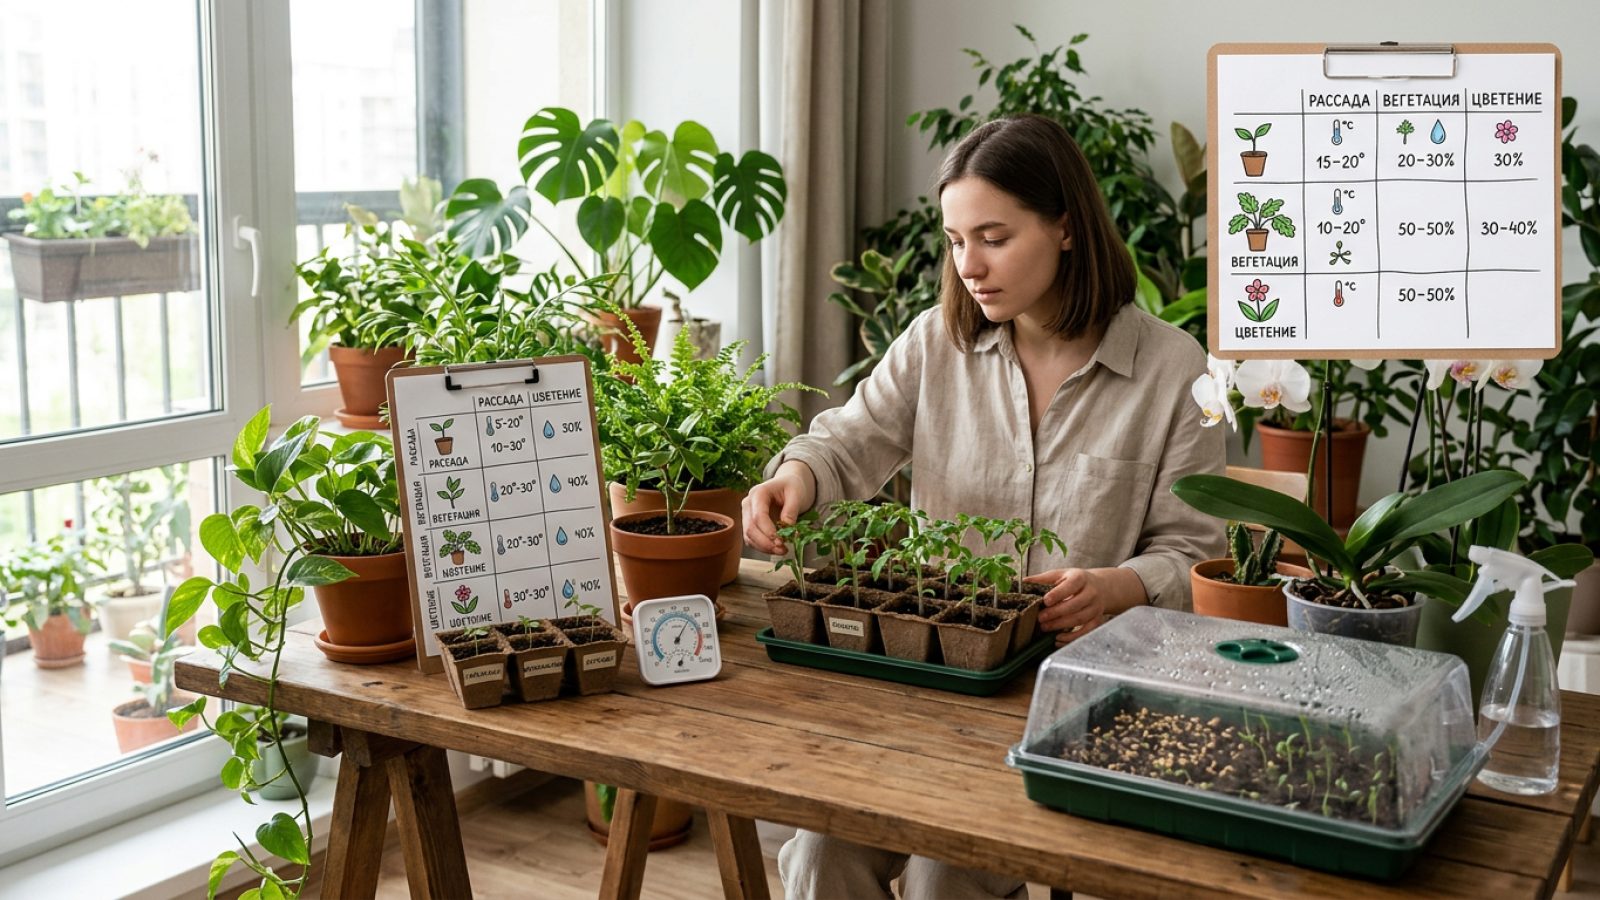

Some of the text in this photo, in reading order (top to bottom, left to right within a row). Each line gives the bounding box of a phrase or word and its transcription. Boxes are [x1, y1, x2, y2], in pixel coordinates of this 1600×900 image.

[1309, 94, 1370, 108] РАССАДА
[1383, 94, 1460, 109] ВЕГЕТАЦИЯ
[1472, 92, 1542, 108] ЦВЕТЕНИЕ
[1398, 152, 1455, 168] 20-30%
[1494, 152, 1523, 167] 30%
[1398, 221, 1455, 236] 50-50%
[1481, 220, 1538, 236] 30-40%
[1231, 256, 1299, 269] ВЕГЕТАЦИЯ
[1398, 287, 1455, 303] 50-50%
[1235, 326, 1296, 340] ЦВЕТЕНИЕ
[478, 394, 524, 407] РАССАДА
[562, 421, 582, 433] 30%
[568, 475, 588, 487] 40%
